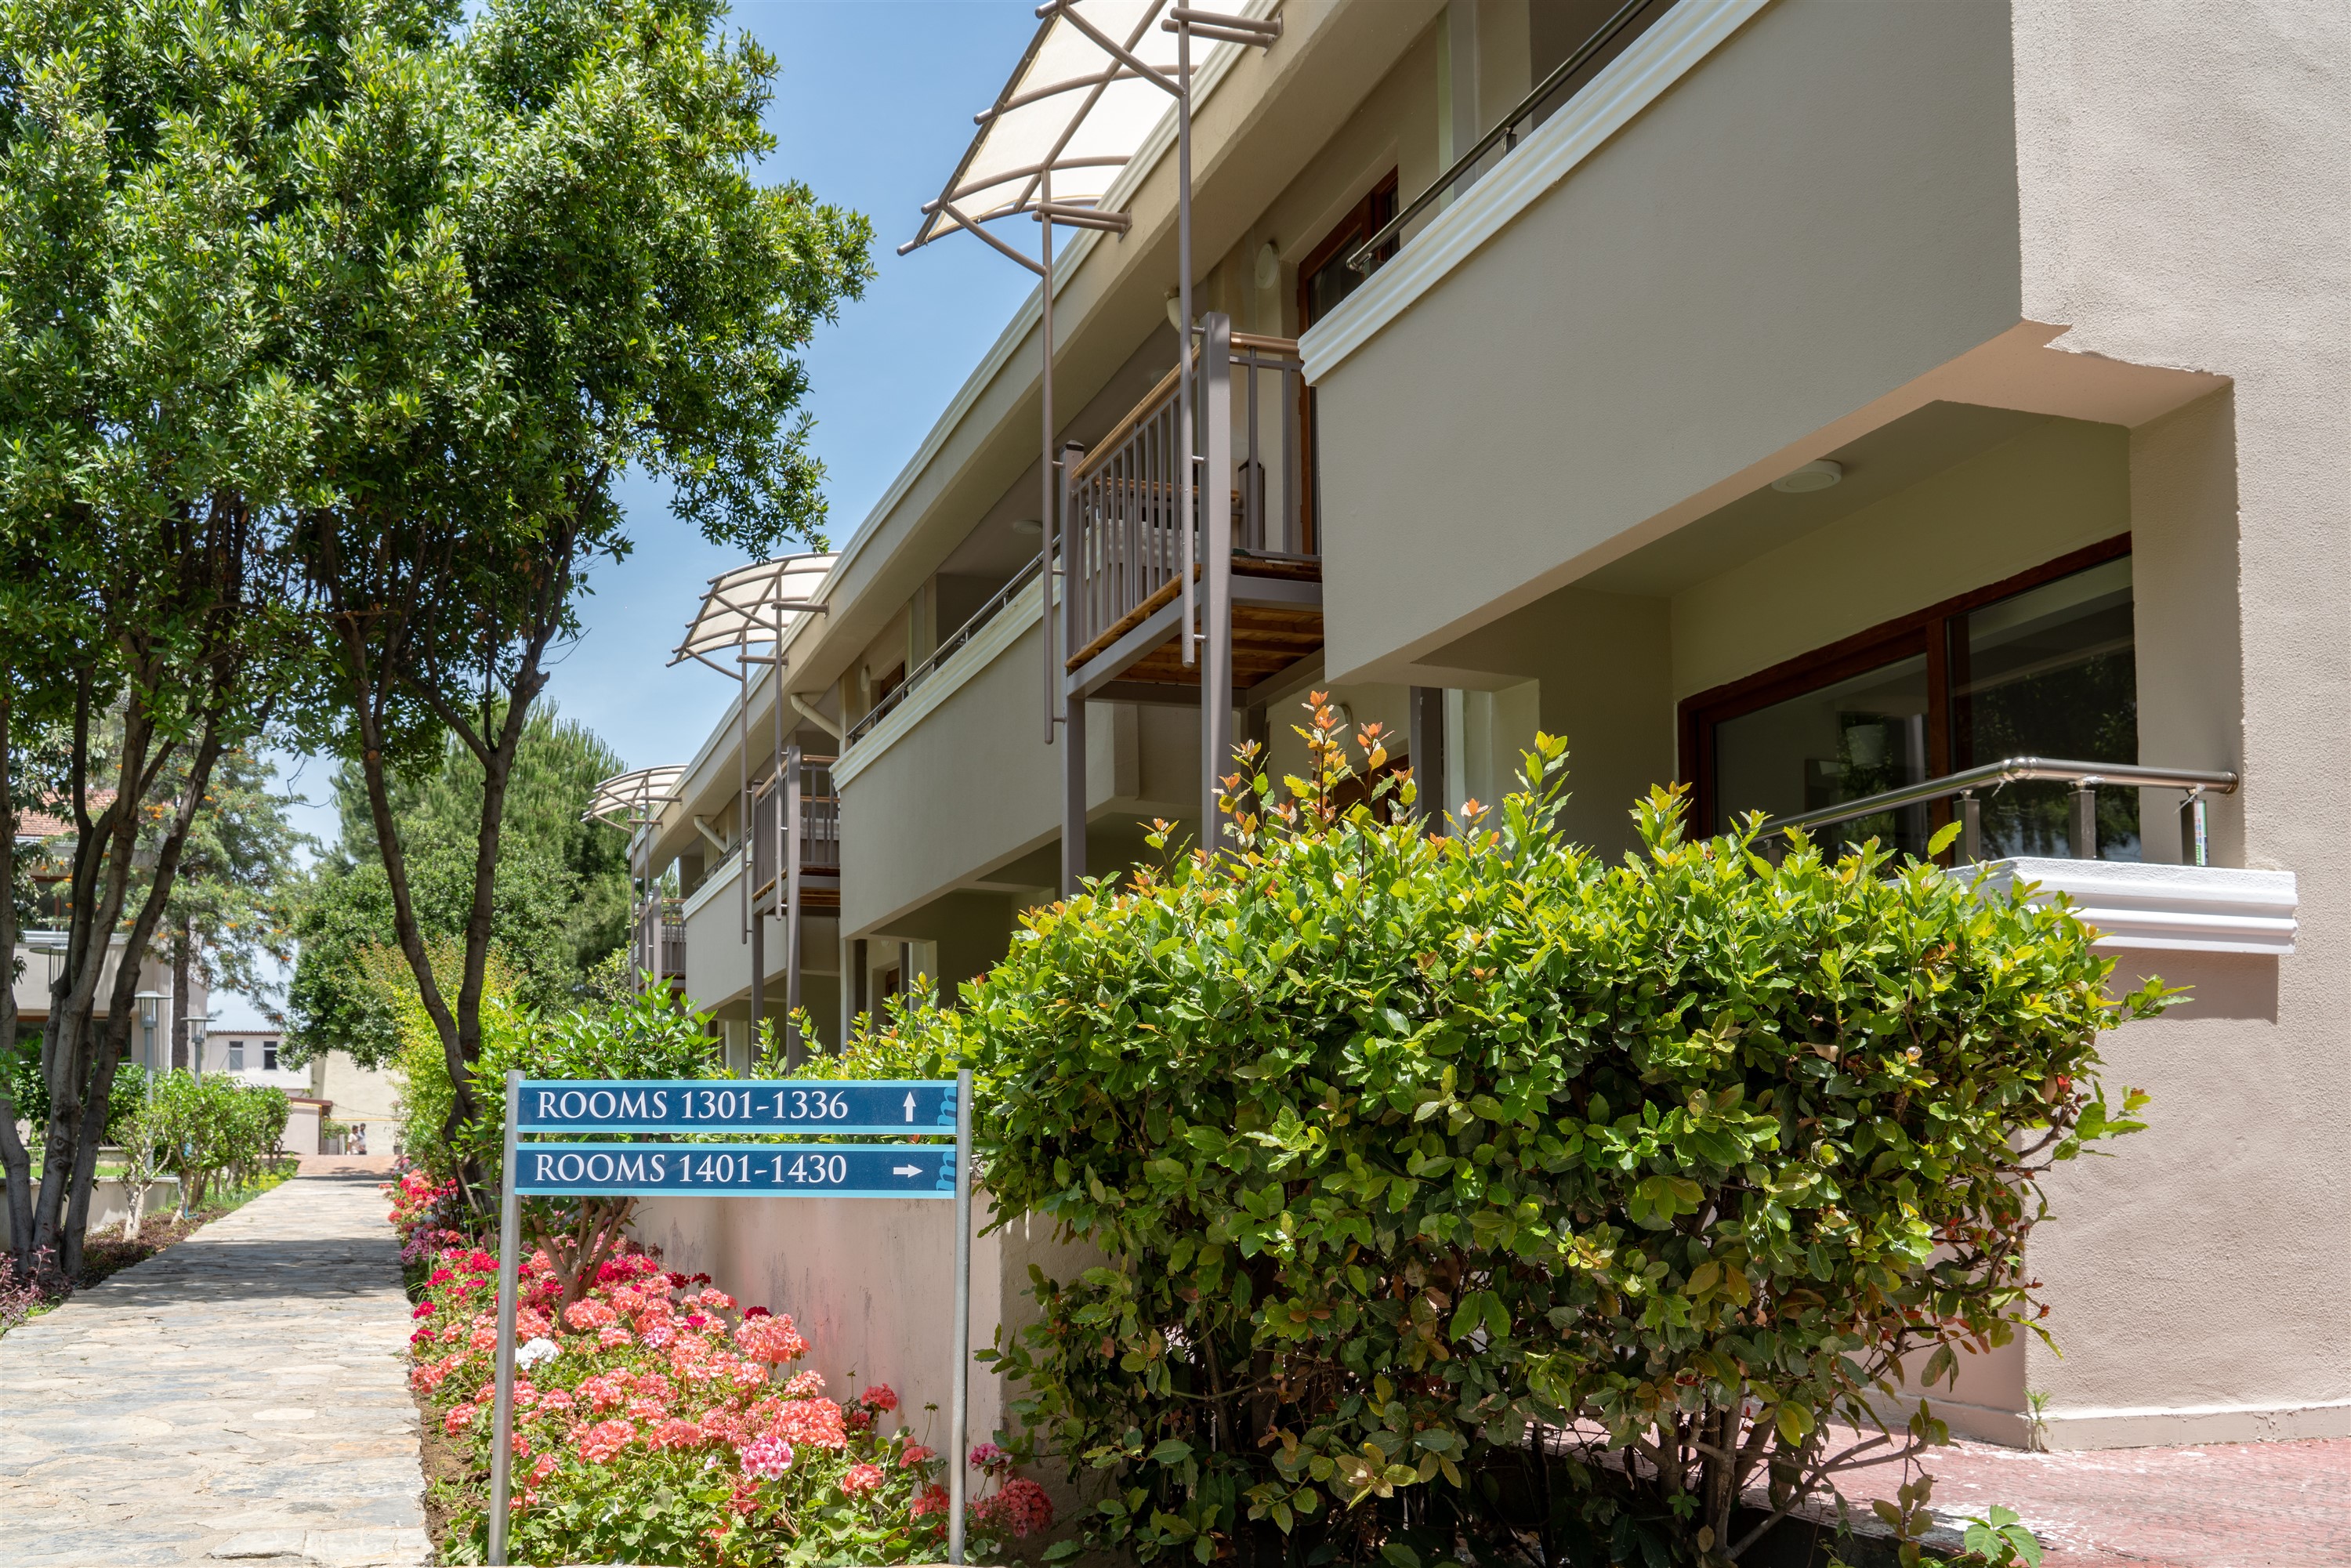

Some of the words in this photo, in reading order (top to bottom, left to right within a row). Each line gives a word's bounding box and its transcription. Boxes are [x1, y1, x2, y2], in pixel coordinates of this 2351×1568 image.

[537, 1091, 668, 1119] ROOMS
[681, 1091, 849, 1119] 1301-1336
[534, 1153, 665, 1182] ROOMS
[679, 1154, 847, 1183] 1401-1430
